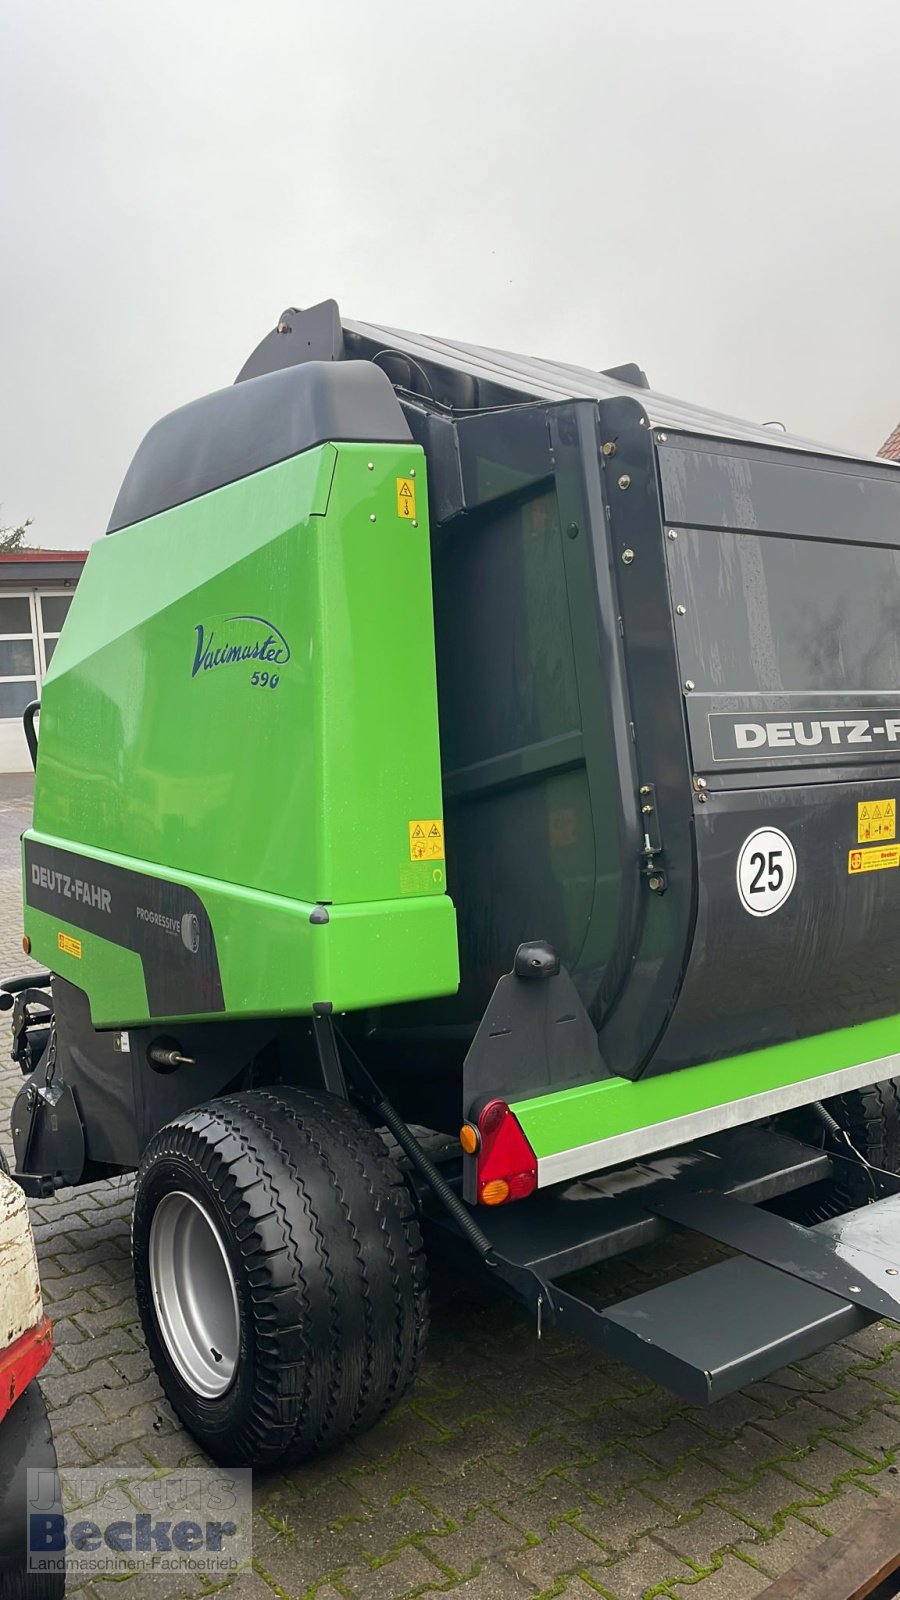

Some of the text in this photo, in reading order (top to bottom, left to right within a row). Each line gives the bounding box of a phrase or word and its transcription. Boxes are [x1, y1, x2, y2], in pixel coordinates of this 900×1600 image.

[250, 671, 279, 688] 590
[734, 719, 900, 748] DEUTZ-F
[750, 851, 783, 893] 25
[31, 864, 112, 913] DEUTZ-FAHR
[136, 906, 181, 933] PROGRESSIVE
